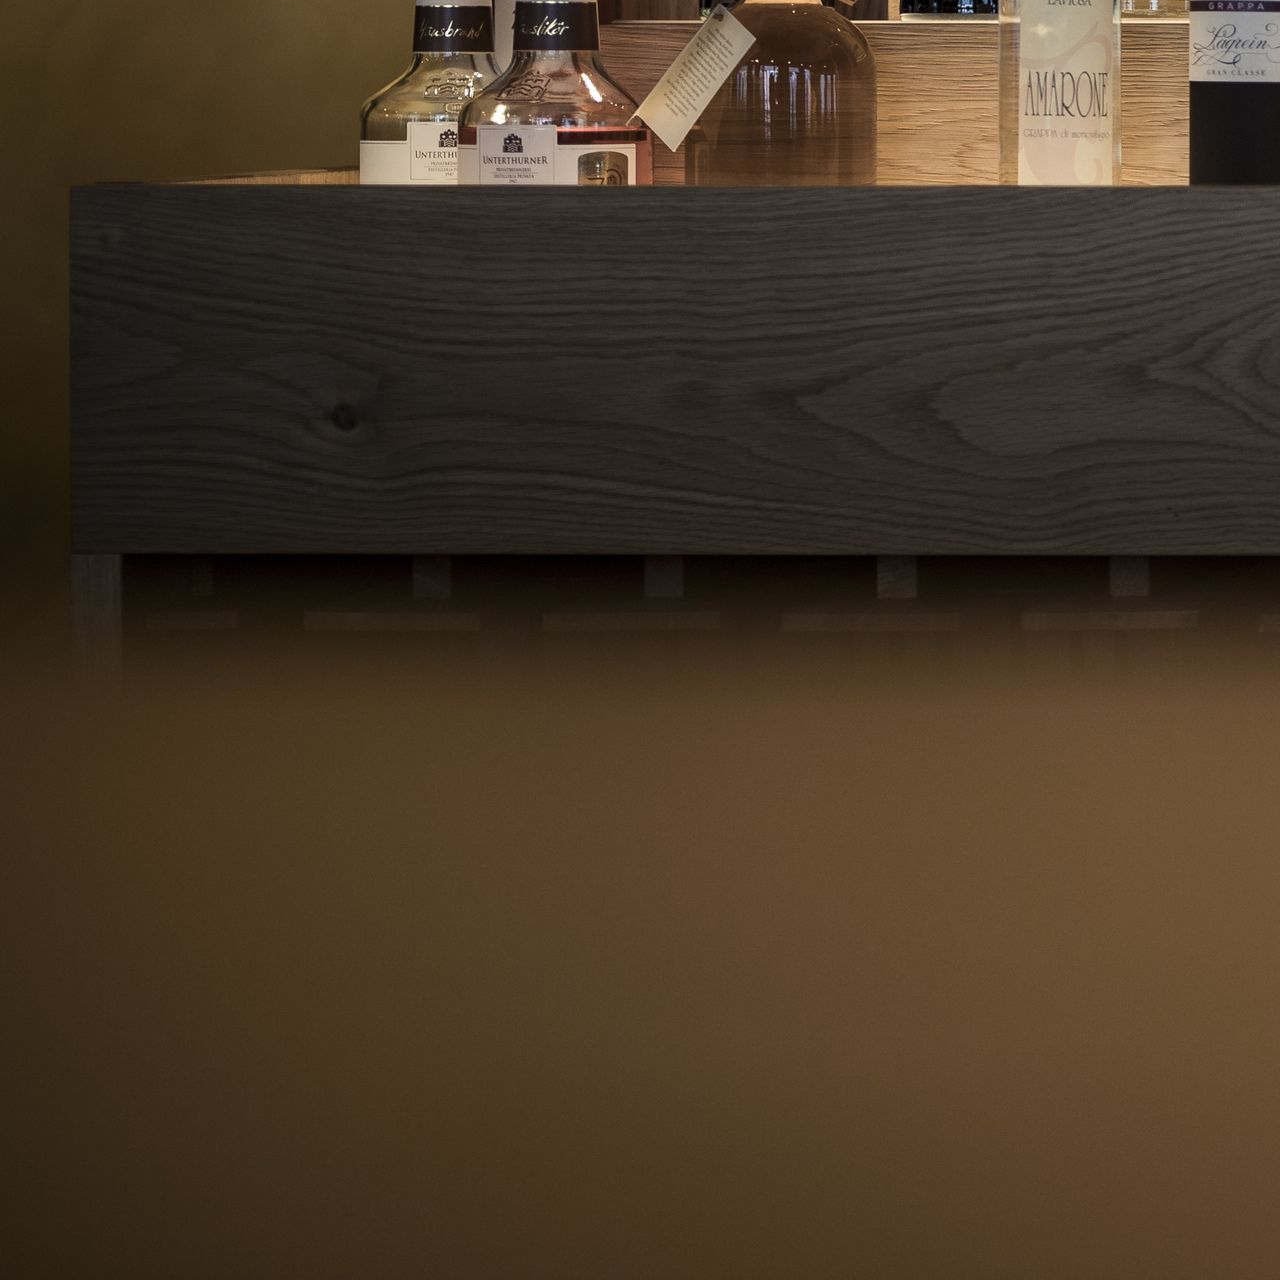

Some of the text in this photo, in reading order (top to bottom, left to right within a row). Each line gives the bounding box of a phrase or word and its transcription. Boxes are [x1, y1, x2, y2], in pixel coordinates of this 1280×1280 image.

[1207, 1, 1266, 11] GRAPPA
[1024, 69, 1109, 118] AMARONE
[482, 155, 549, 165] UNTERTHURNER
